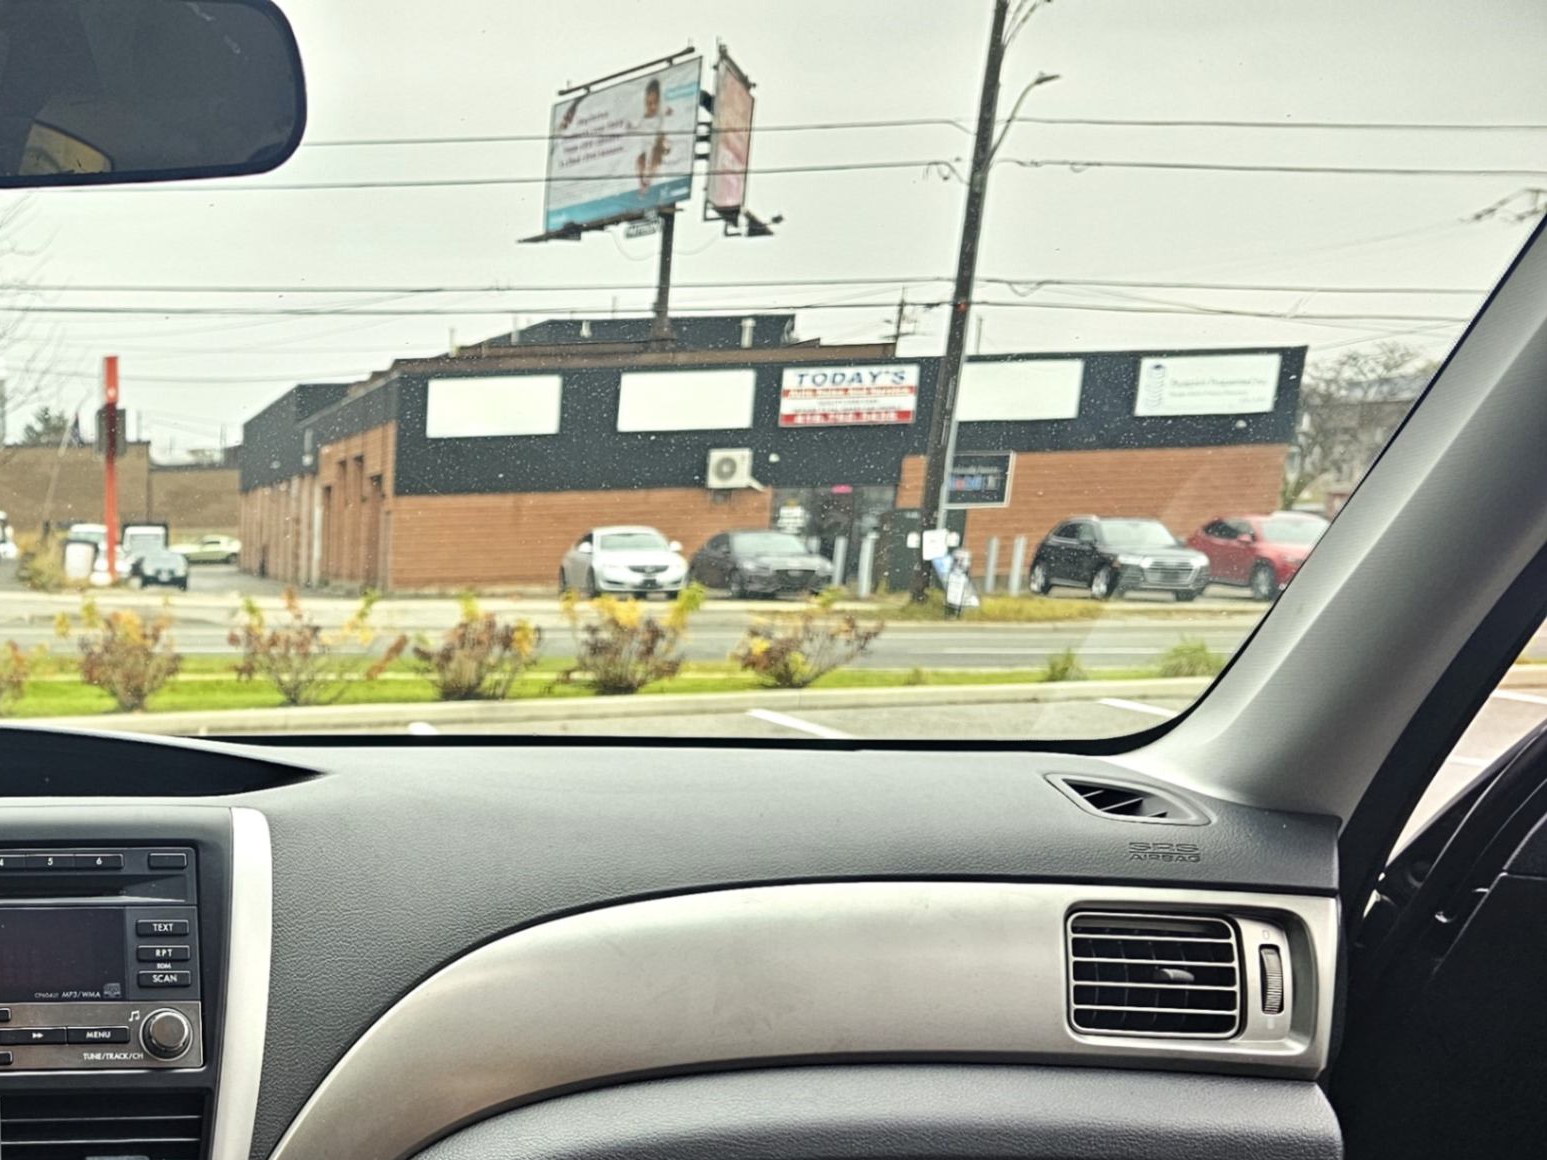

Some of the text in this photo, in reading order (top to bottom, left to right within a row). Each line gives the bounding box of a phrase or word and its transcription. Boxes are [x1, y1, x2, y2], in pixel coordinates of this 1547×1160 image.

[797, 369, 906, 387] TODAY'S
[1129, 842, 1199, 853] SRS
[1129, 854, 1201, 863] AIRBAG
[152, 923, 173, 932] TEXT
[155, 948, 173, 957] RPT
[152, 974, 178, 983] SCAN
[86, 1031, 111, 1039] MENU
[83, 1052, 144, 1060] TUNE/TRACK/CH
